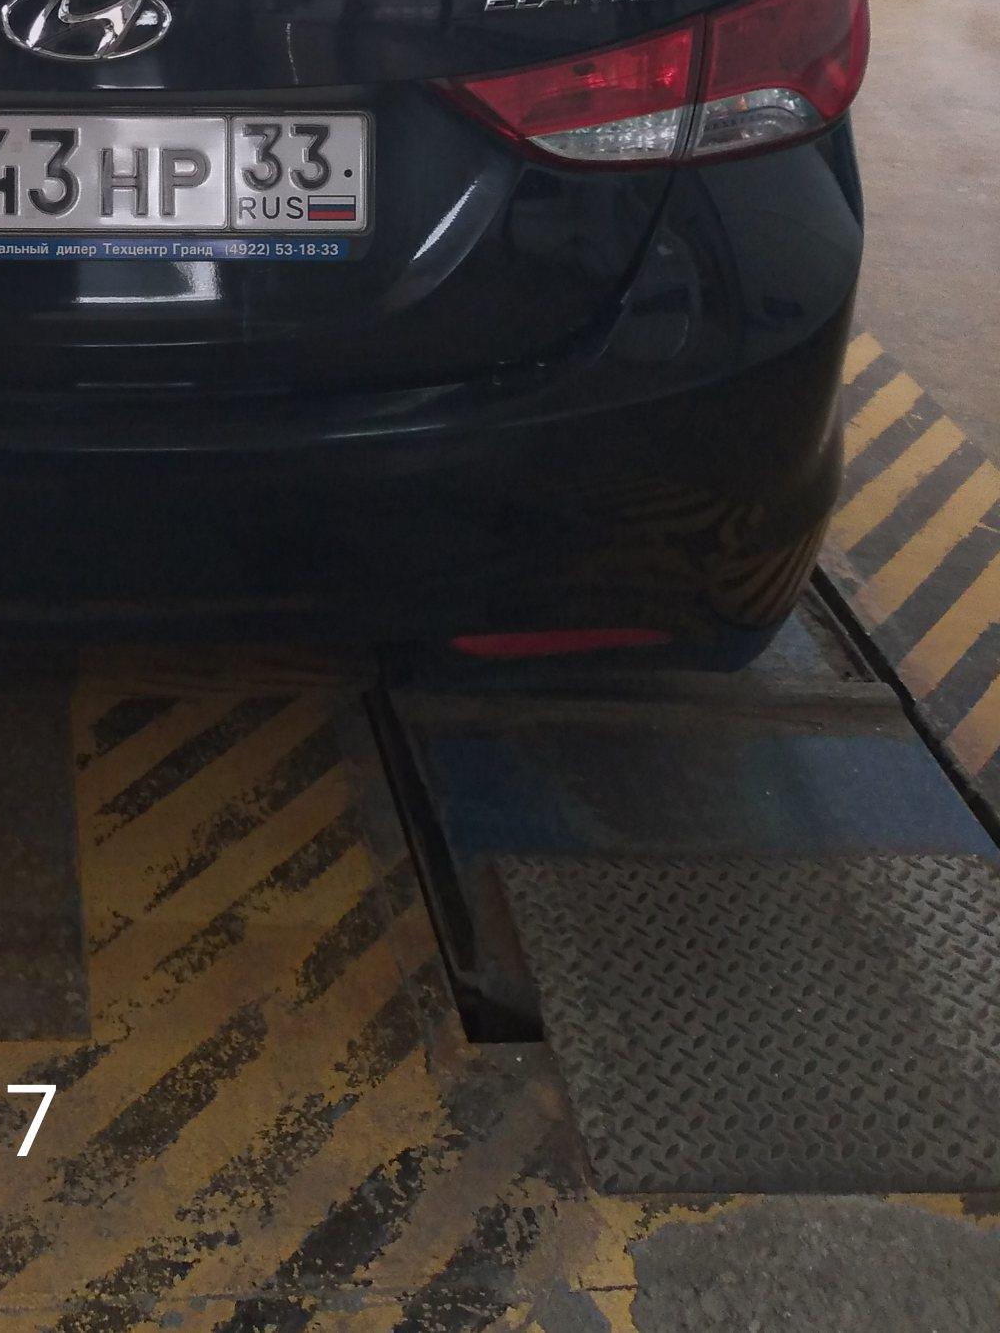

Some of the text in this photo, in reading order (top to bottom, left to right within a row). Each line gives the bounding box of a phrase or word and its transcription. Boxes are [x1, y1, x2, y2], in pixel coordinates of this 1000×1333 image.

[237, 195, 305, 220] RUS
[56, 244, 97, 257] дилер
[103, 242, 168, 257] Техцентр
[173, 243, 213, 257] Гранд
[225, 242, 270, 257] (4922)
[275, 242, 339, 256] 53-18-33
